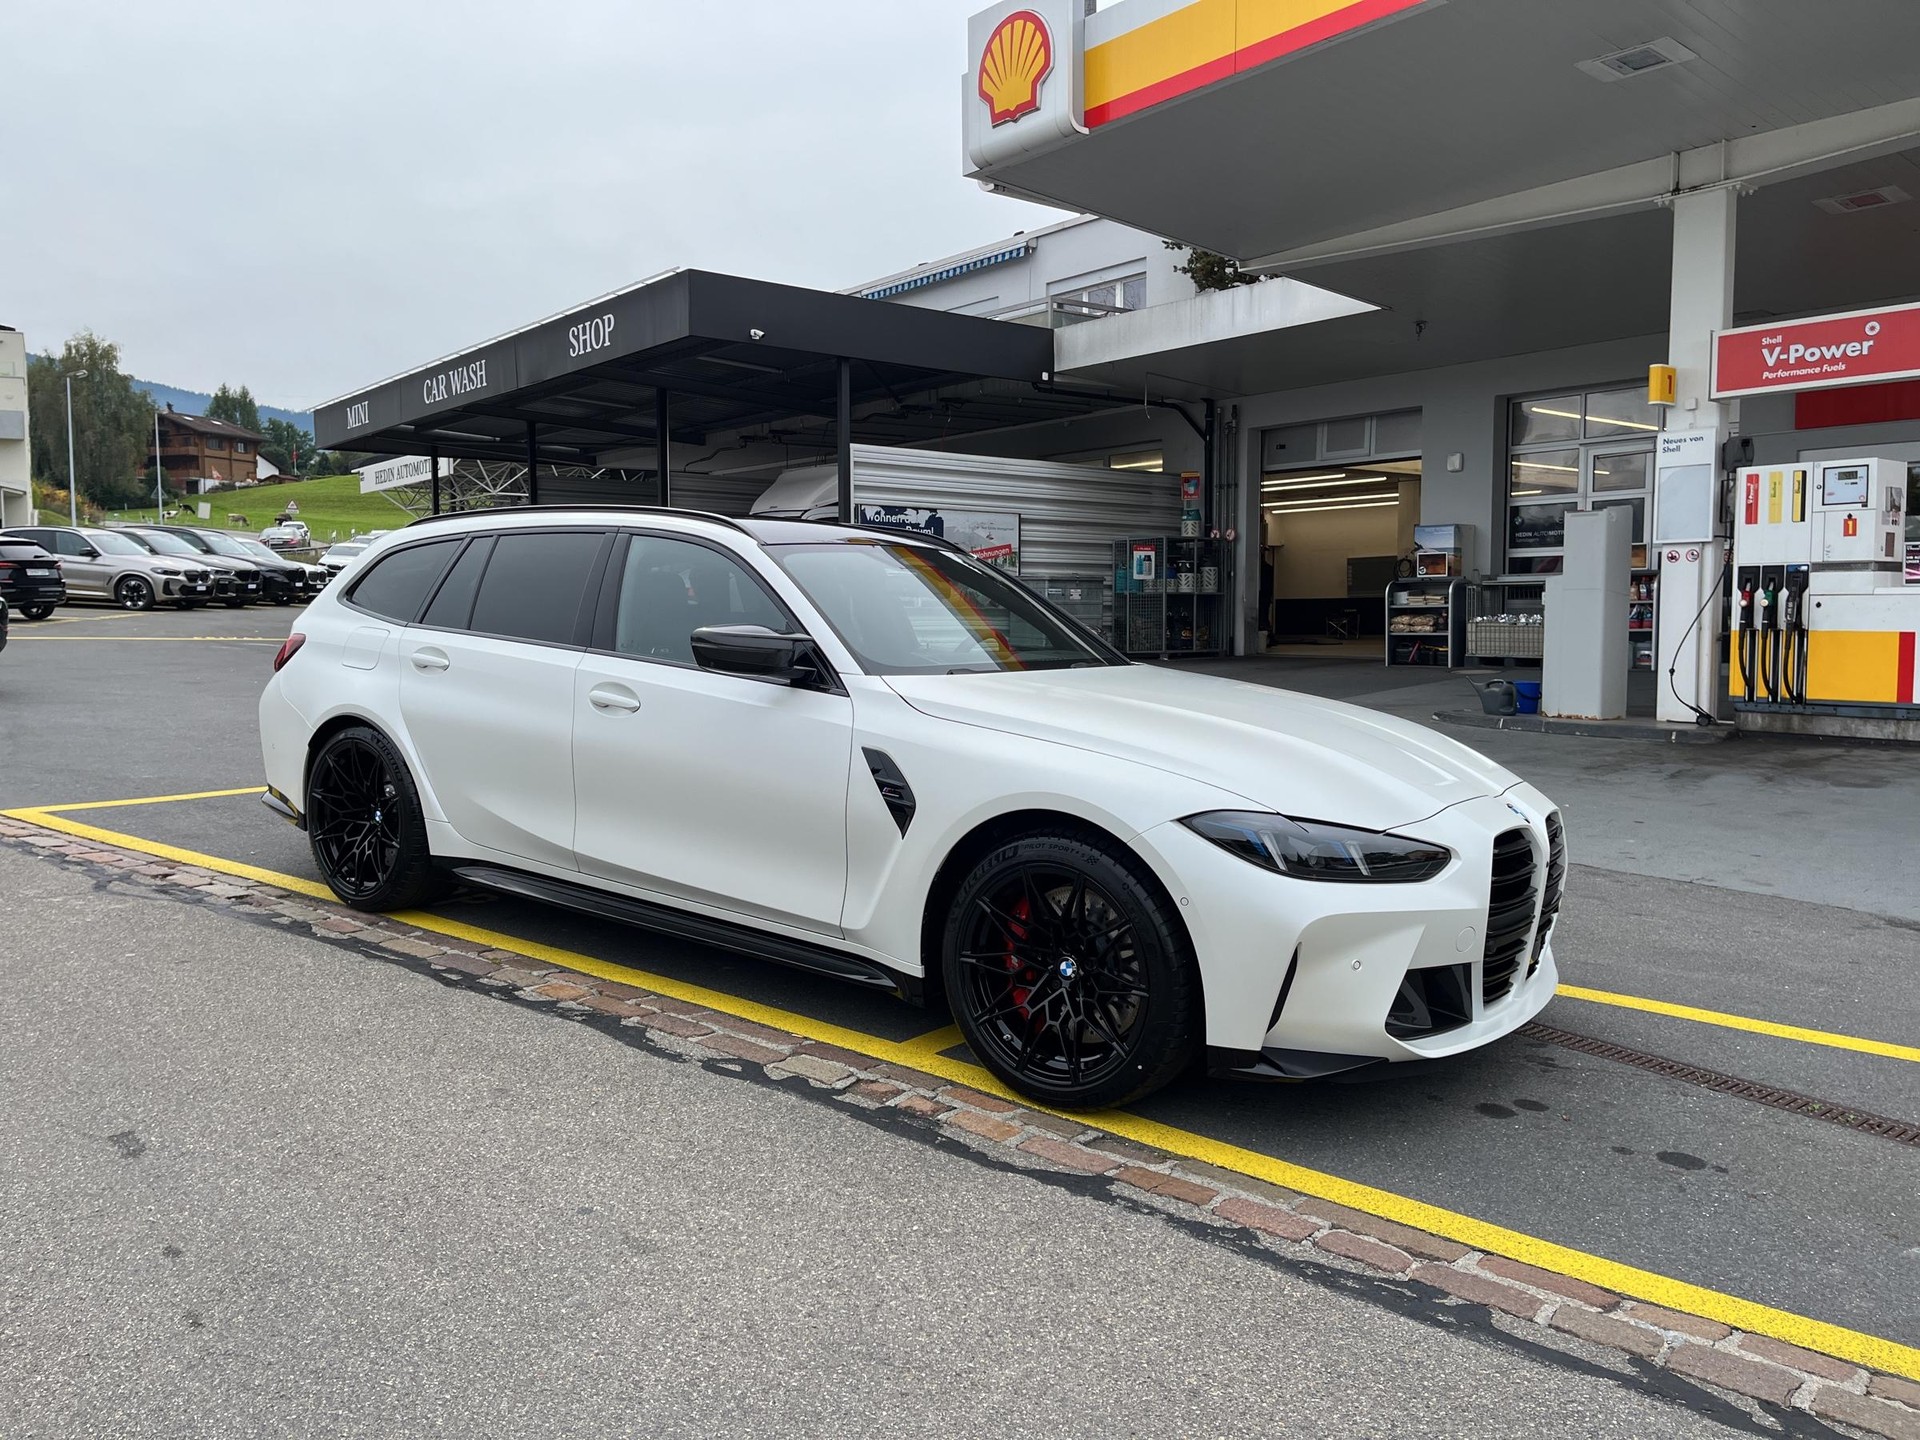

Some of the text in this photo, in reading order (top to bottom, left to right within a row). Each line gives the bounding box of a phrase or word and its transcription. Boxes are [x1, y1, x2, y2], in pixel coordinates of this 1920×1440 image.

[568, 313, 615, 357] SHOP
[1762, 335, 1782, 345] Shell
[1761, 340, 1874, 367] V-Power
[1762, 362, 1846, 380] Performance Fuels
[423, 359, 487, 404] CAR WASH
[1667, 374, 1673, 395] 1
[346, 400, 370, 429] MINI
[1662, 445, 1681, 454] Shell
[1663, 436, 1687, 445] Neues
[374, 466, 395, 485] HEDIN
[396, 458, 441, 481] AUTOMOTI
[1847, 520, 1853, 535] 1
[1048, 843, 1075, 854] SPORT
